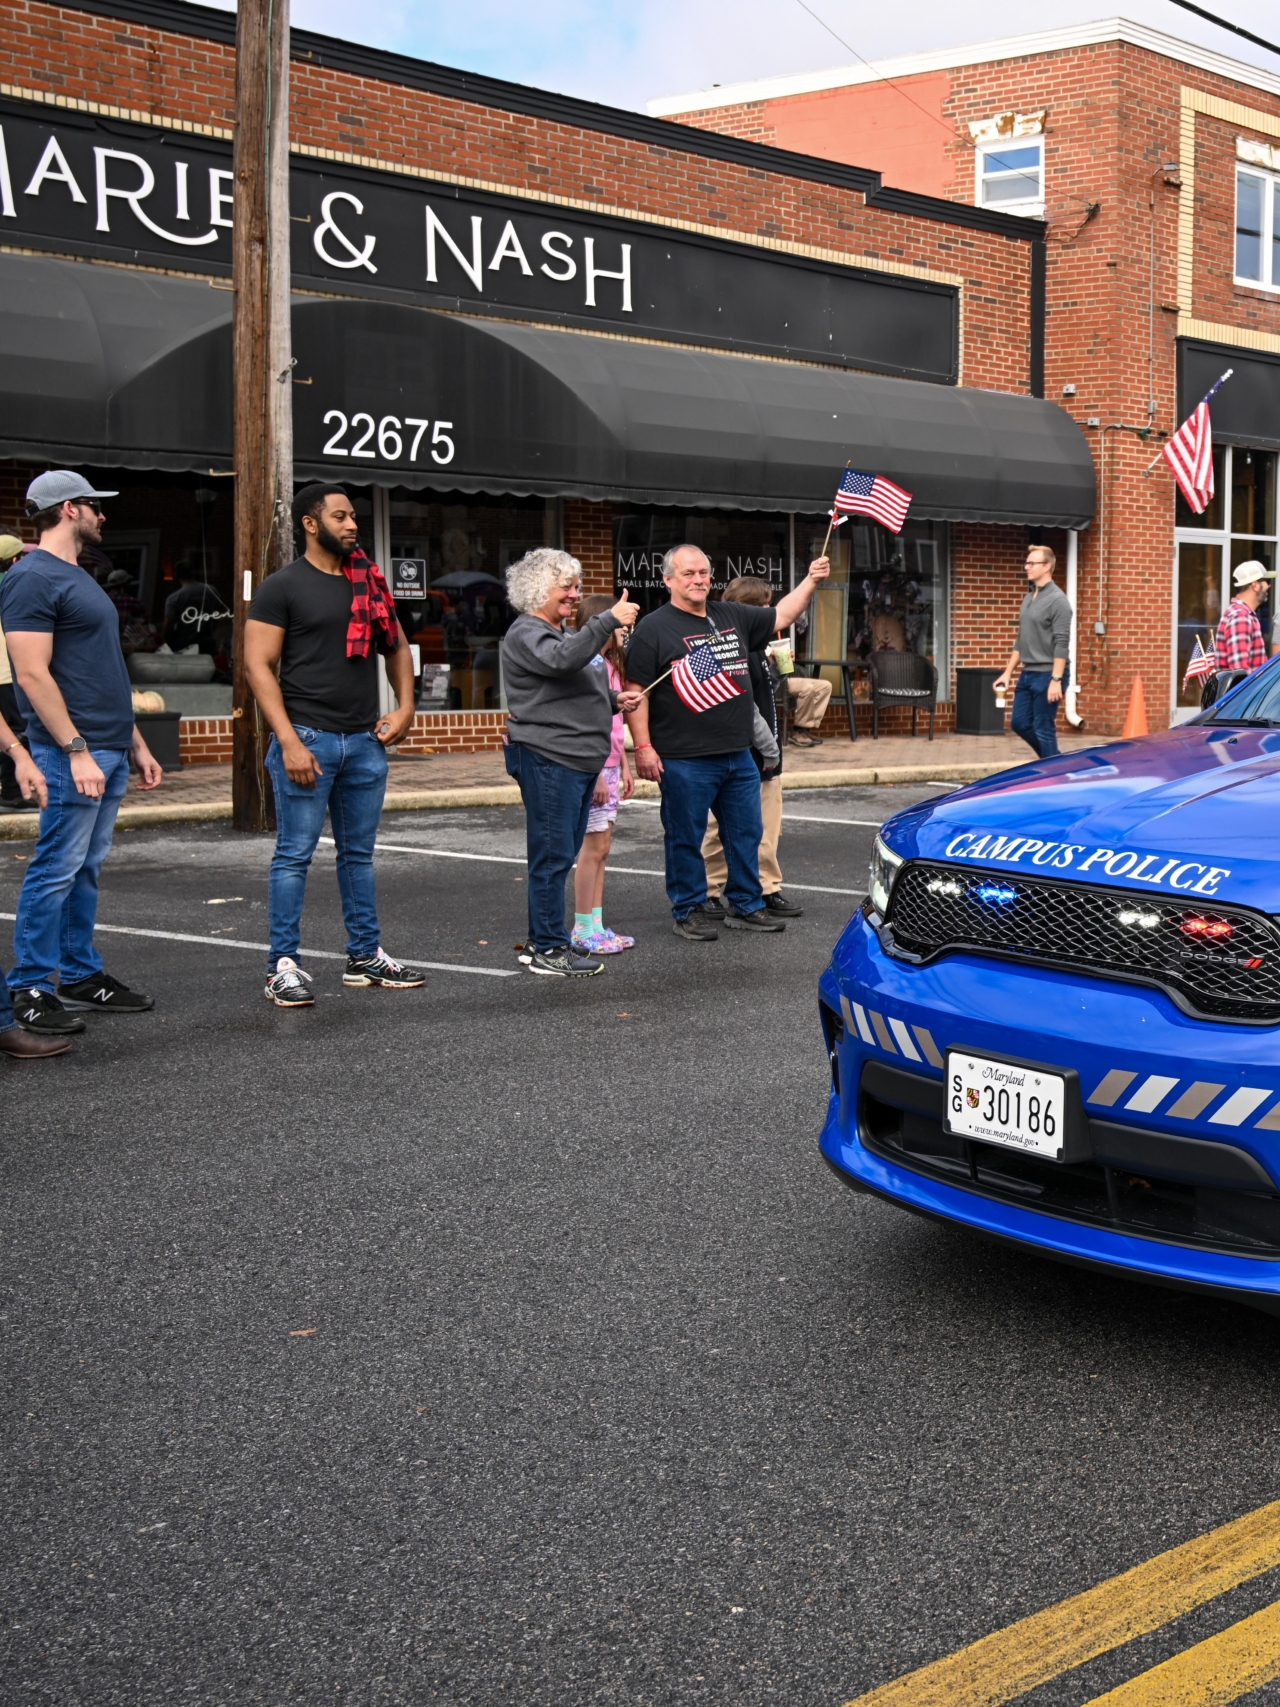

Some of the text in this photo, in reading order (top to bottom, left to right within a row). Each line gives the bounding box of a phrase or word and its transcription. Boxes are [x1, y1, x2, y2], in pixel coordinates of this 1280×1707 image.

[0, 124, 633, 312] ARIE & NASH
[323, 410, 455, 465] 22675
[727, 556, 783, 582] NASH
[617, 579, 643, 588] SMALL
[645, 580, 666, 589] BATC
[181, 606, 235, 632] Open
[945, 833, 1231, 896] CAMPUS POLICE
[1180, 951, 1251, 967] DODGE
[982, 1067, 1026, 1087] Maryland
[983, 1085, 1055, 1137] 30186
[974, 1125, 1035, 1147] www.maryland.gov
